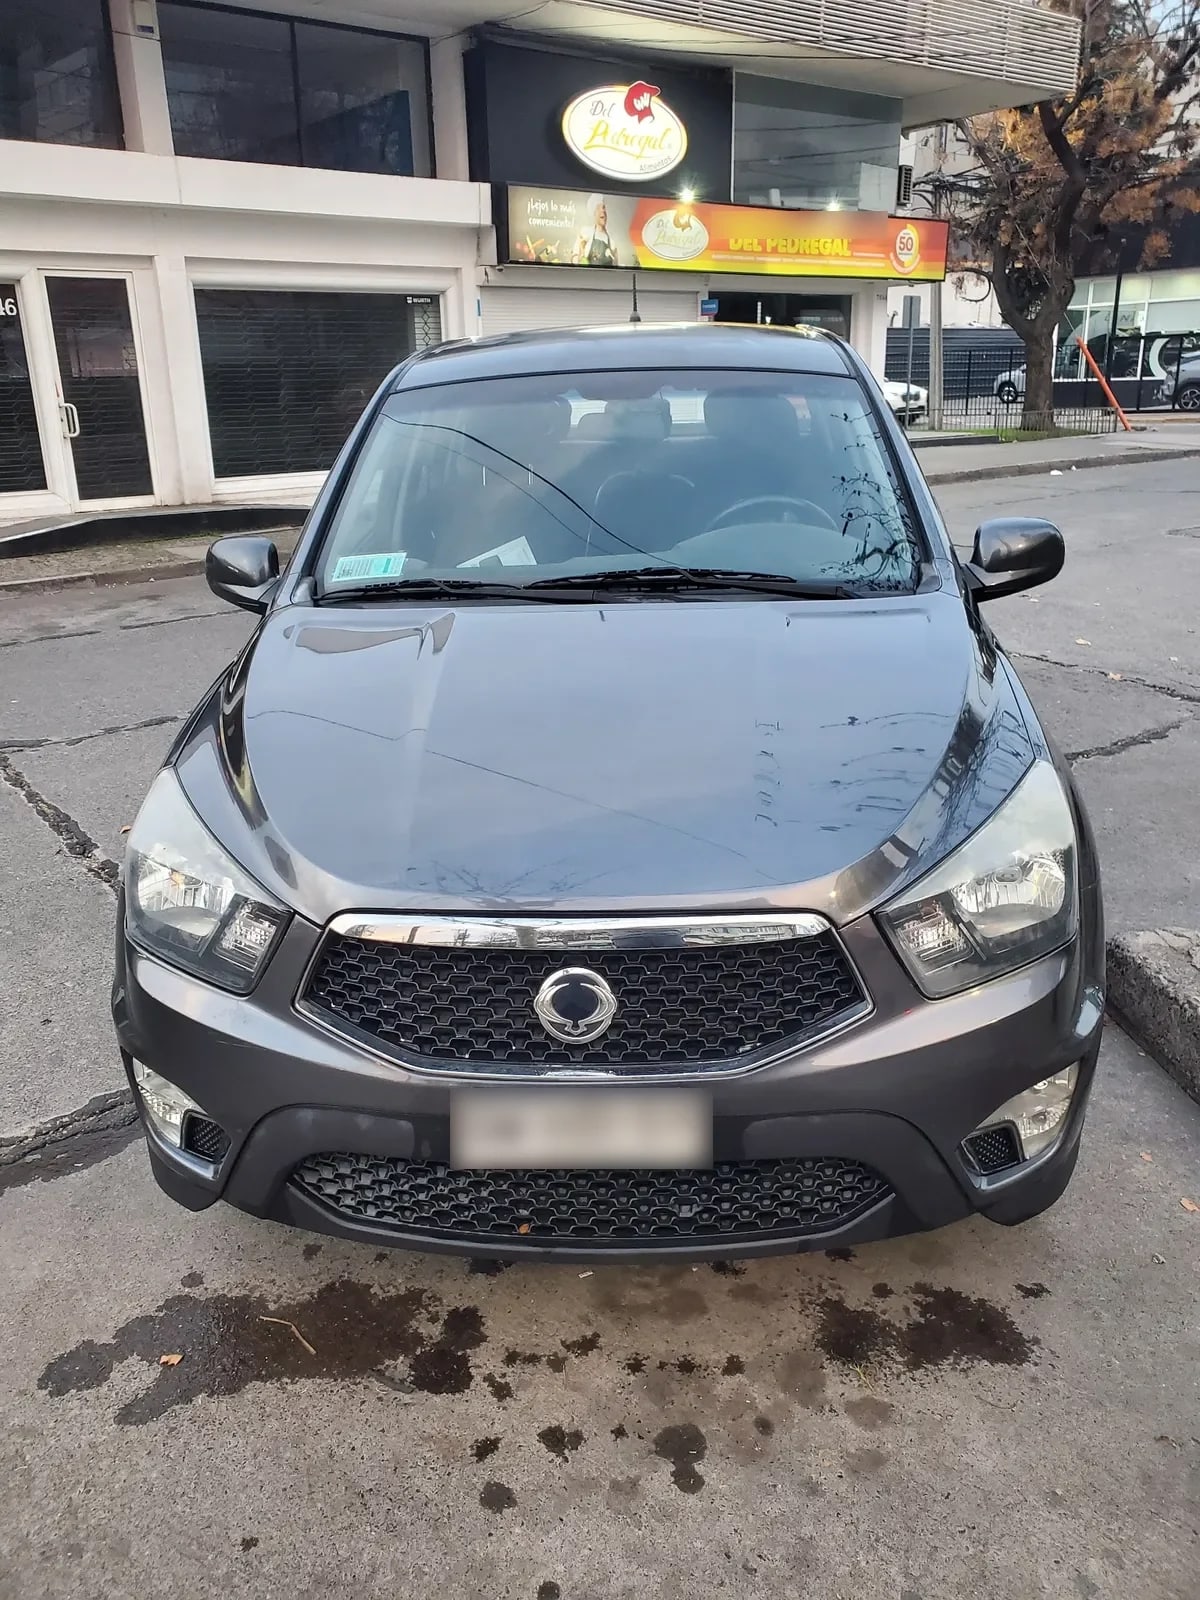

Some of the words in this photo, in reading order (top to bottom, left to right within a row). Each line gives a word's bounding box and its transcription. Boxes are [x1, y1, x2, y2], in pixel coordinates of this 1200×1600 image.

[589, 100, 616, 118] Del
[583, 119, 672, 160] Pedregal
[551, 200, 559, 212] lo
[729, 238, 762, 252] DEL
[766, 238, 852, 257] PEDREGAL
[898, 236, 914, 252] 50
